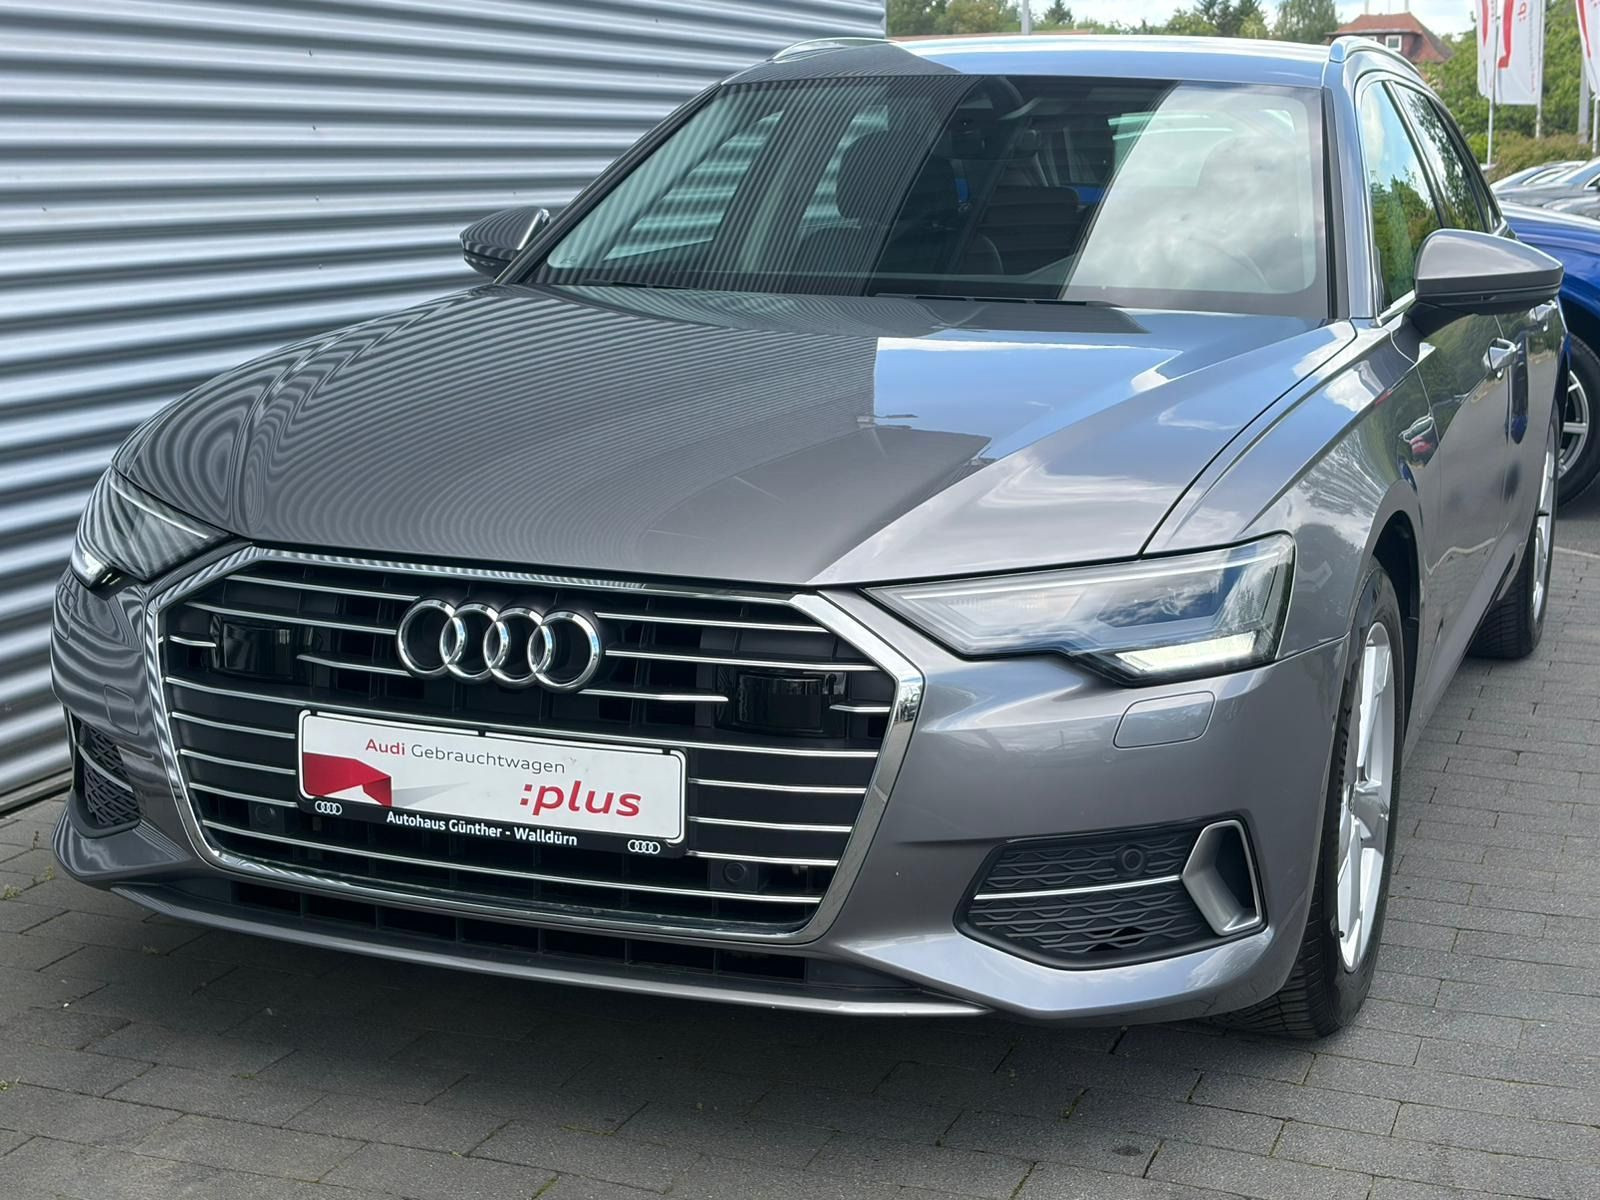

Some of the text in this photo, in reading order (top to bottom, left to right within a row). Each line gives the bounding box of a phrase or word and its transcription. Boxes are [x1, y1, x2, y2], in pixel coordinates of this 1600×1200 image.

[365, 738, 566, 775] Audi Gebrauchtwagen
[519, 780, 642, 817] :plus
[386, 811, 446, 831] Autohaus
[449, 818, 503, 838] Günther
[513, 826, 578, 847] Walldürn
